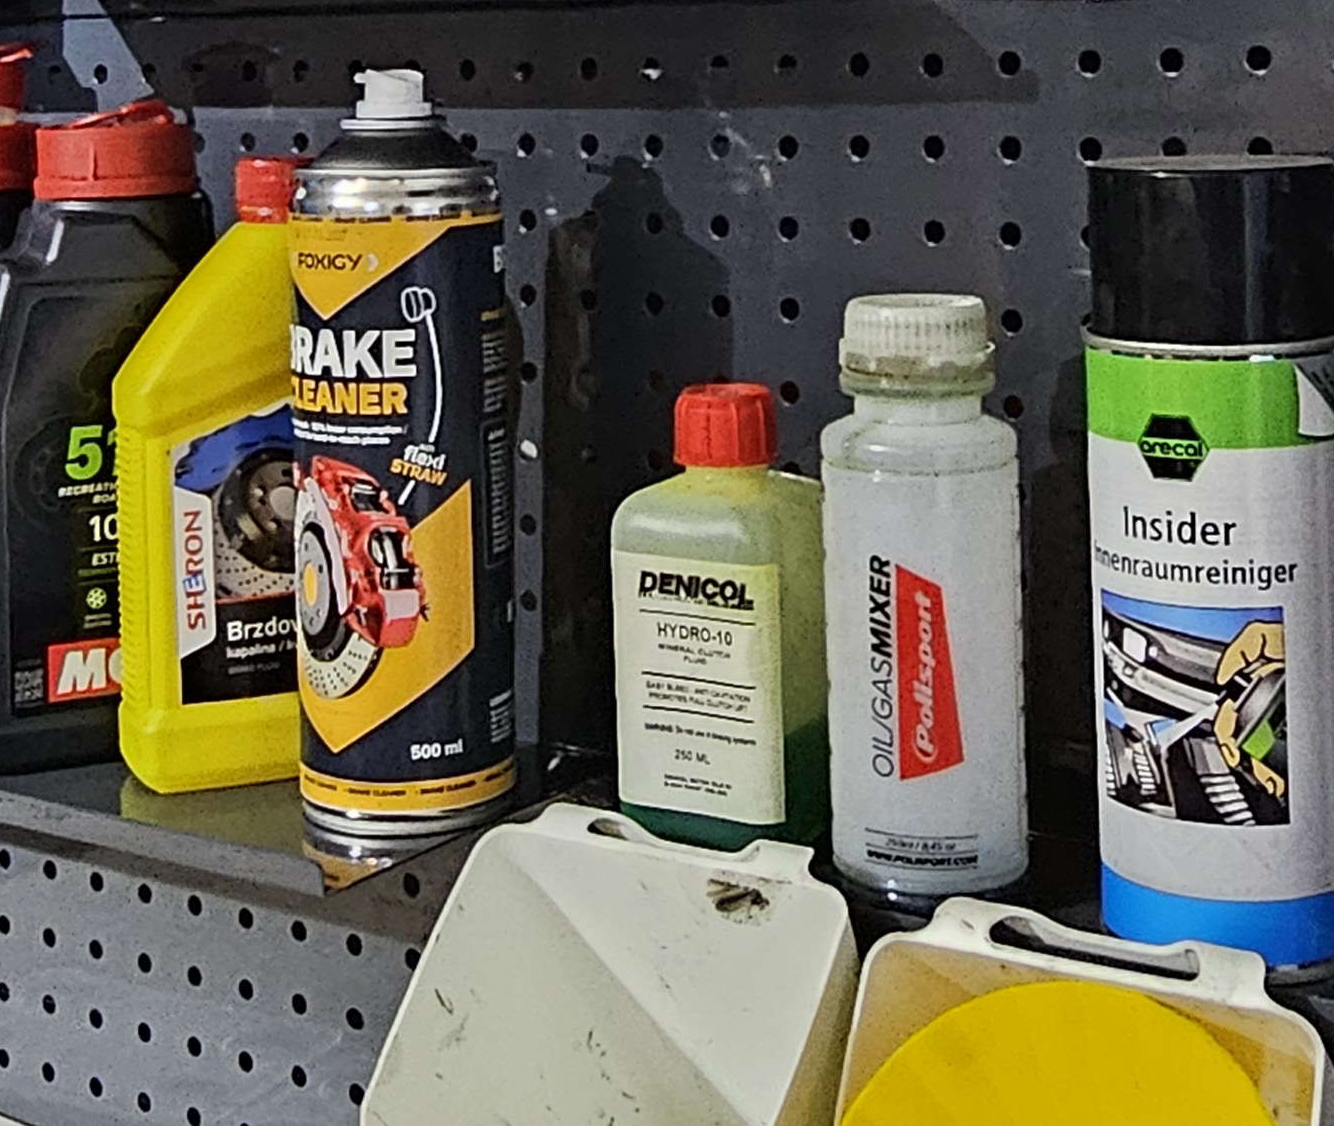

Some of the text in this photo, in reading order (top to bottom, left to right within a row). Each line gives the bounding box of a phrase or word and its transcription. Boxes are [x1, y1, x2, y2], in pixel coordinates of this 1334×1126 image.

[297, 251, 364, 272] FOXIGY
[291, 325, 418, 379] RAKE
[404, 444, 446, 468] flexi
[1139, 439, 1204, 458] arecal
[390, 458, 447, 486] STRAW
[1122, 504, 1238, 547] Insider
[182, 510, 207, 630] SHERON
[639, 569, 754, 609] DENICOL
[656, 621, 733, 647] HYDRO-10
[410, 738, 464, 761] 500 ml
[674, 749, 711, 765] 250 ML
